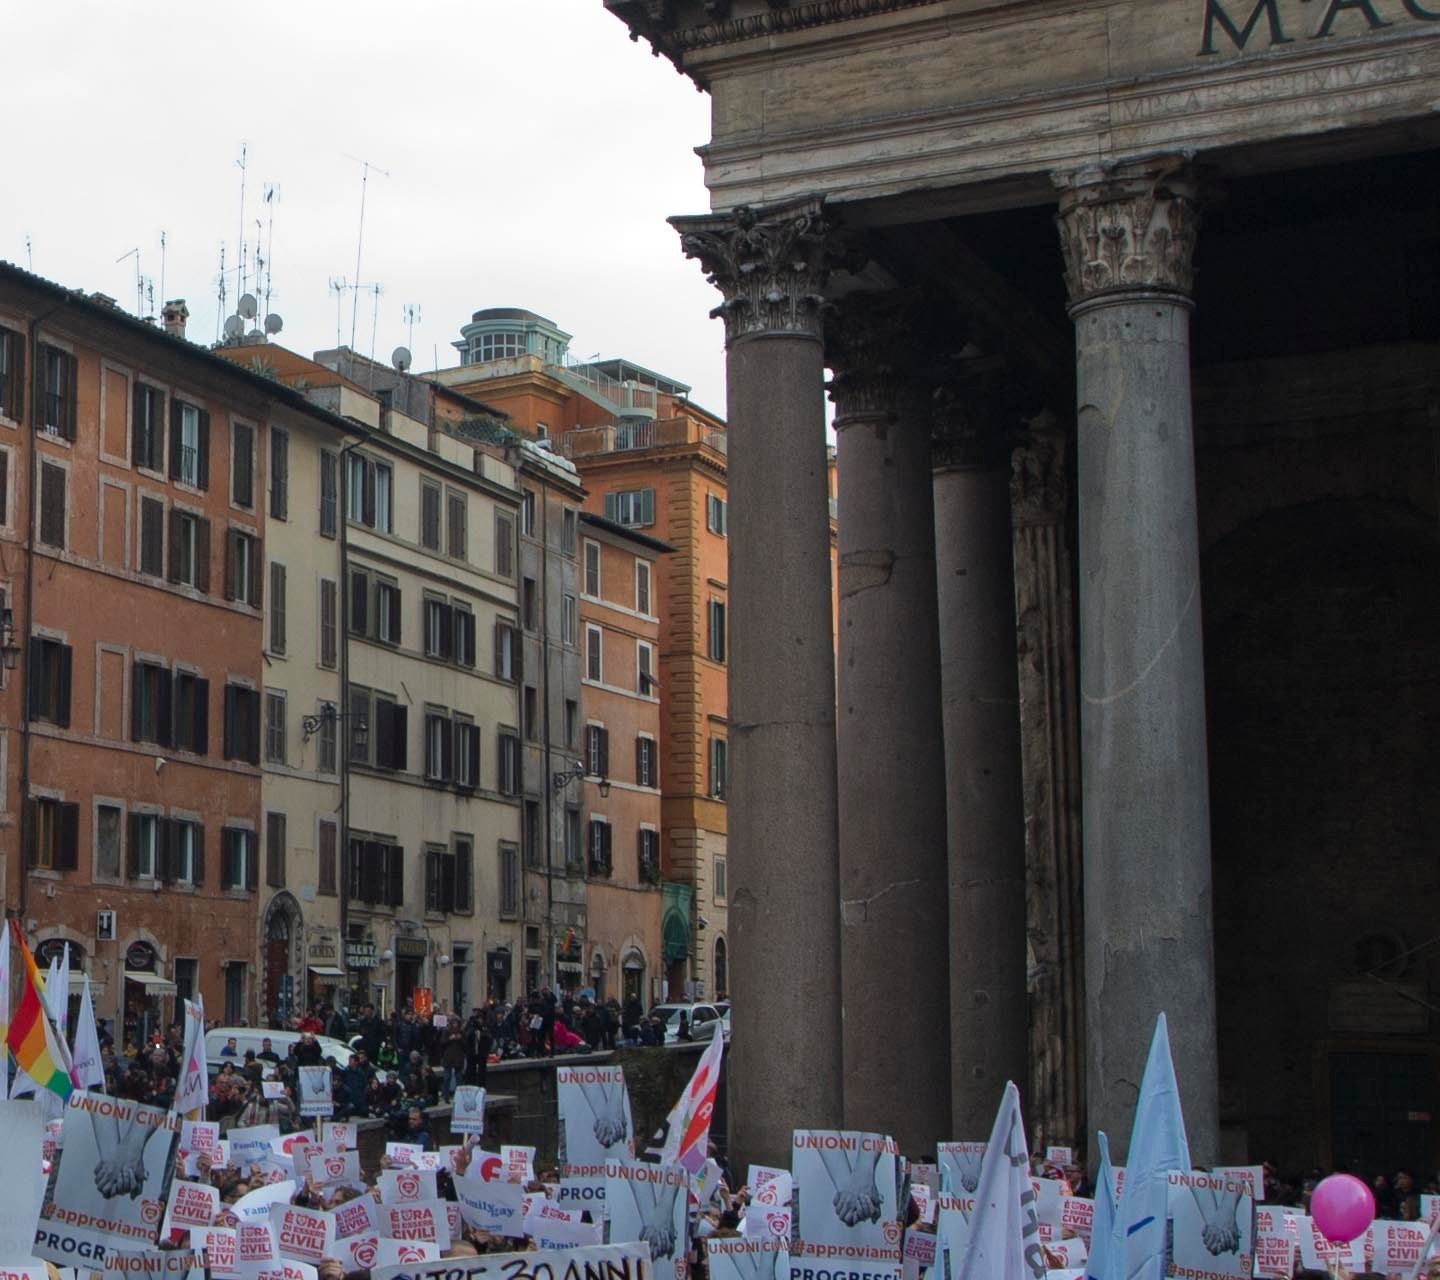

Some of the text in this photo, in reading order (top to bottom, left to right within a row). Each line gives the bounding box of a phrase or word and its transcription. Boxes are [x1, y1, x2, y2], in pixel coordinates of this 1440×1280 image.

[793, 1135, 857, 1152] UNIONI
[1168, 1173, 1222, 1192] UNIONI
[173, 1206, 212, 1220] CIVILI
[284, 1209, 327, 1232] È ORA
[283, 1223, 326, 1239] DI ESSERE
[279, 1233, 324, 1251] CIVILI
[708, 1239, 760, 1255] UNIONI
[793, 1240, 902, 1261] #approviamo
[104, 1254, 162, 1273] UNIONI
